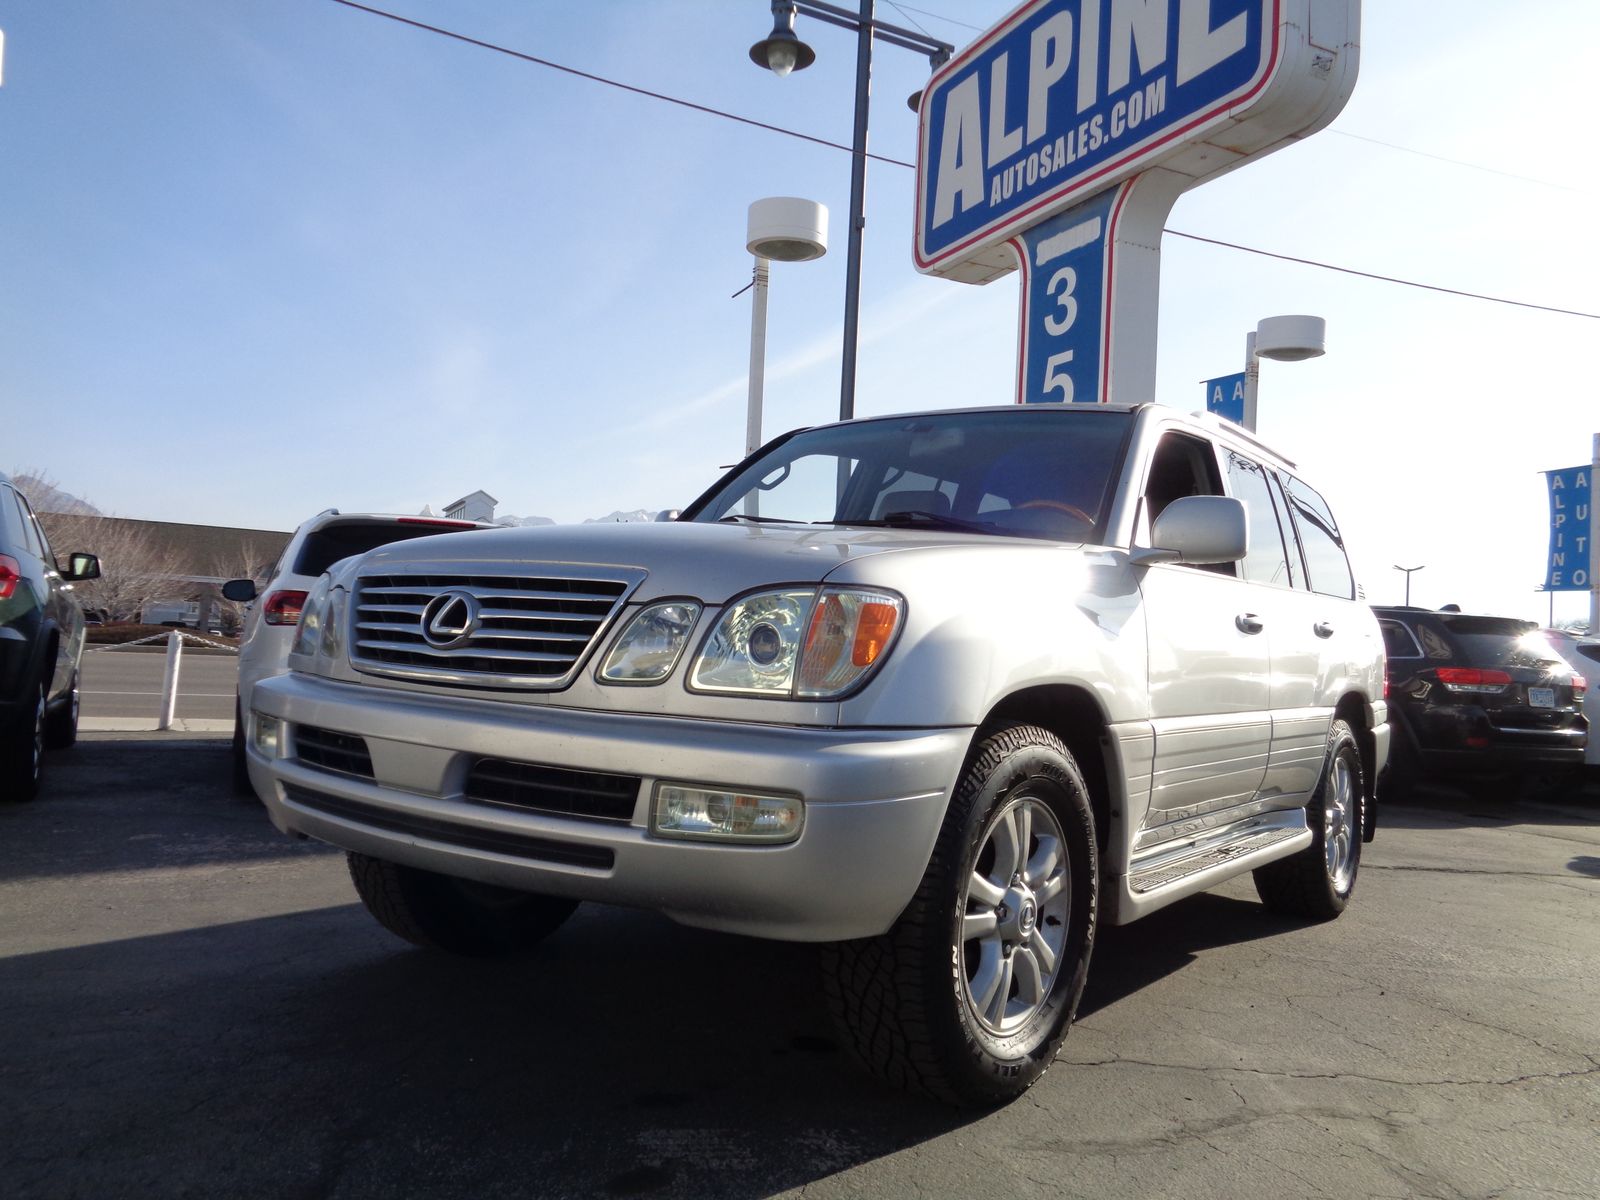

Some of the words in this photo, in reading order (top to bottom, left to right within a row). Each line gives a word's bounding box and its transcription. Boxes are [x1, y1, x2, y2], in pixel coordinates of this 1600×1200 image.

[989, 76, 1167, 207] AUTOSALES.COM
[1551, 474, 1567, 586] ALPINE
[1572, 471, 1588, 586] AUTO
